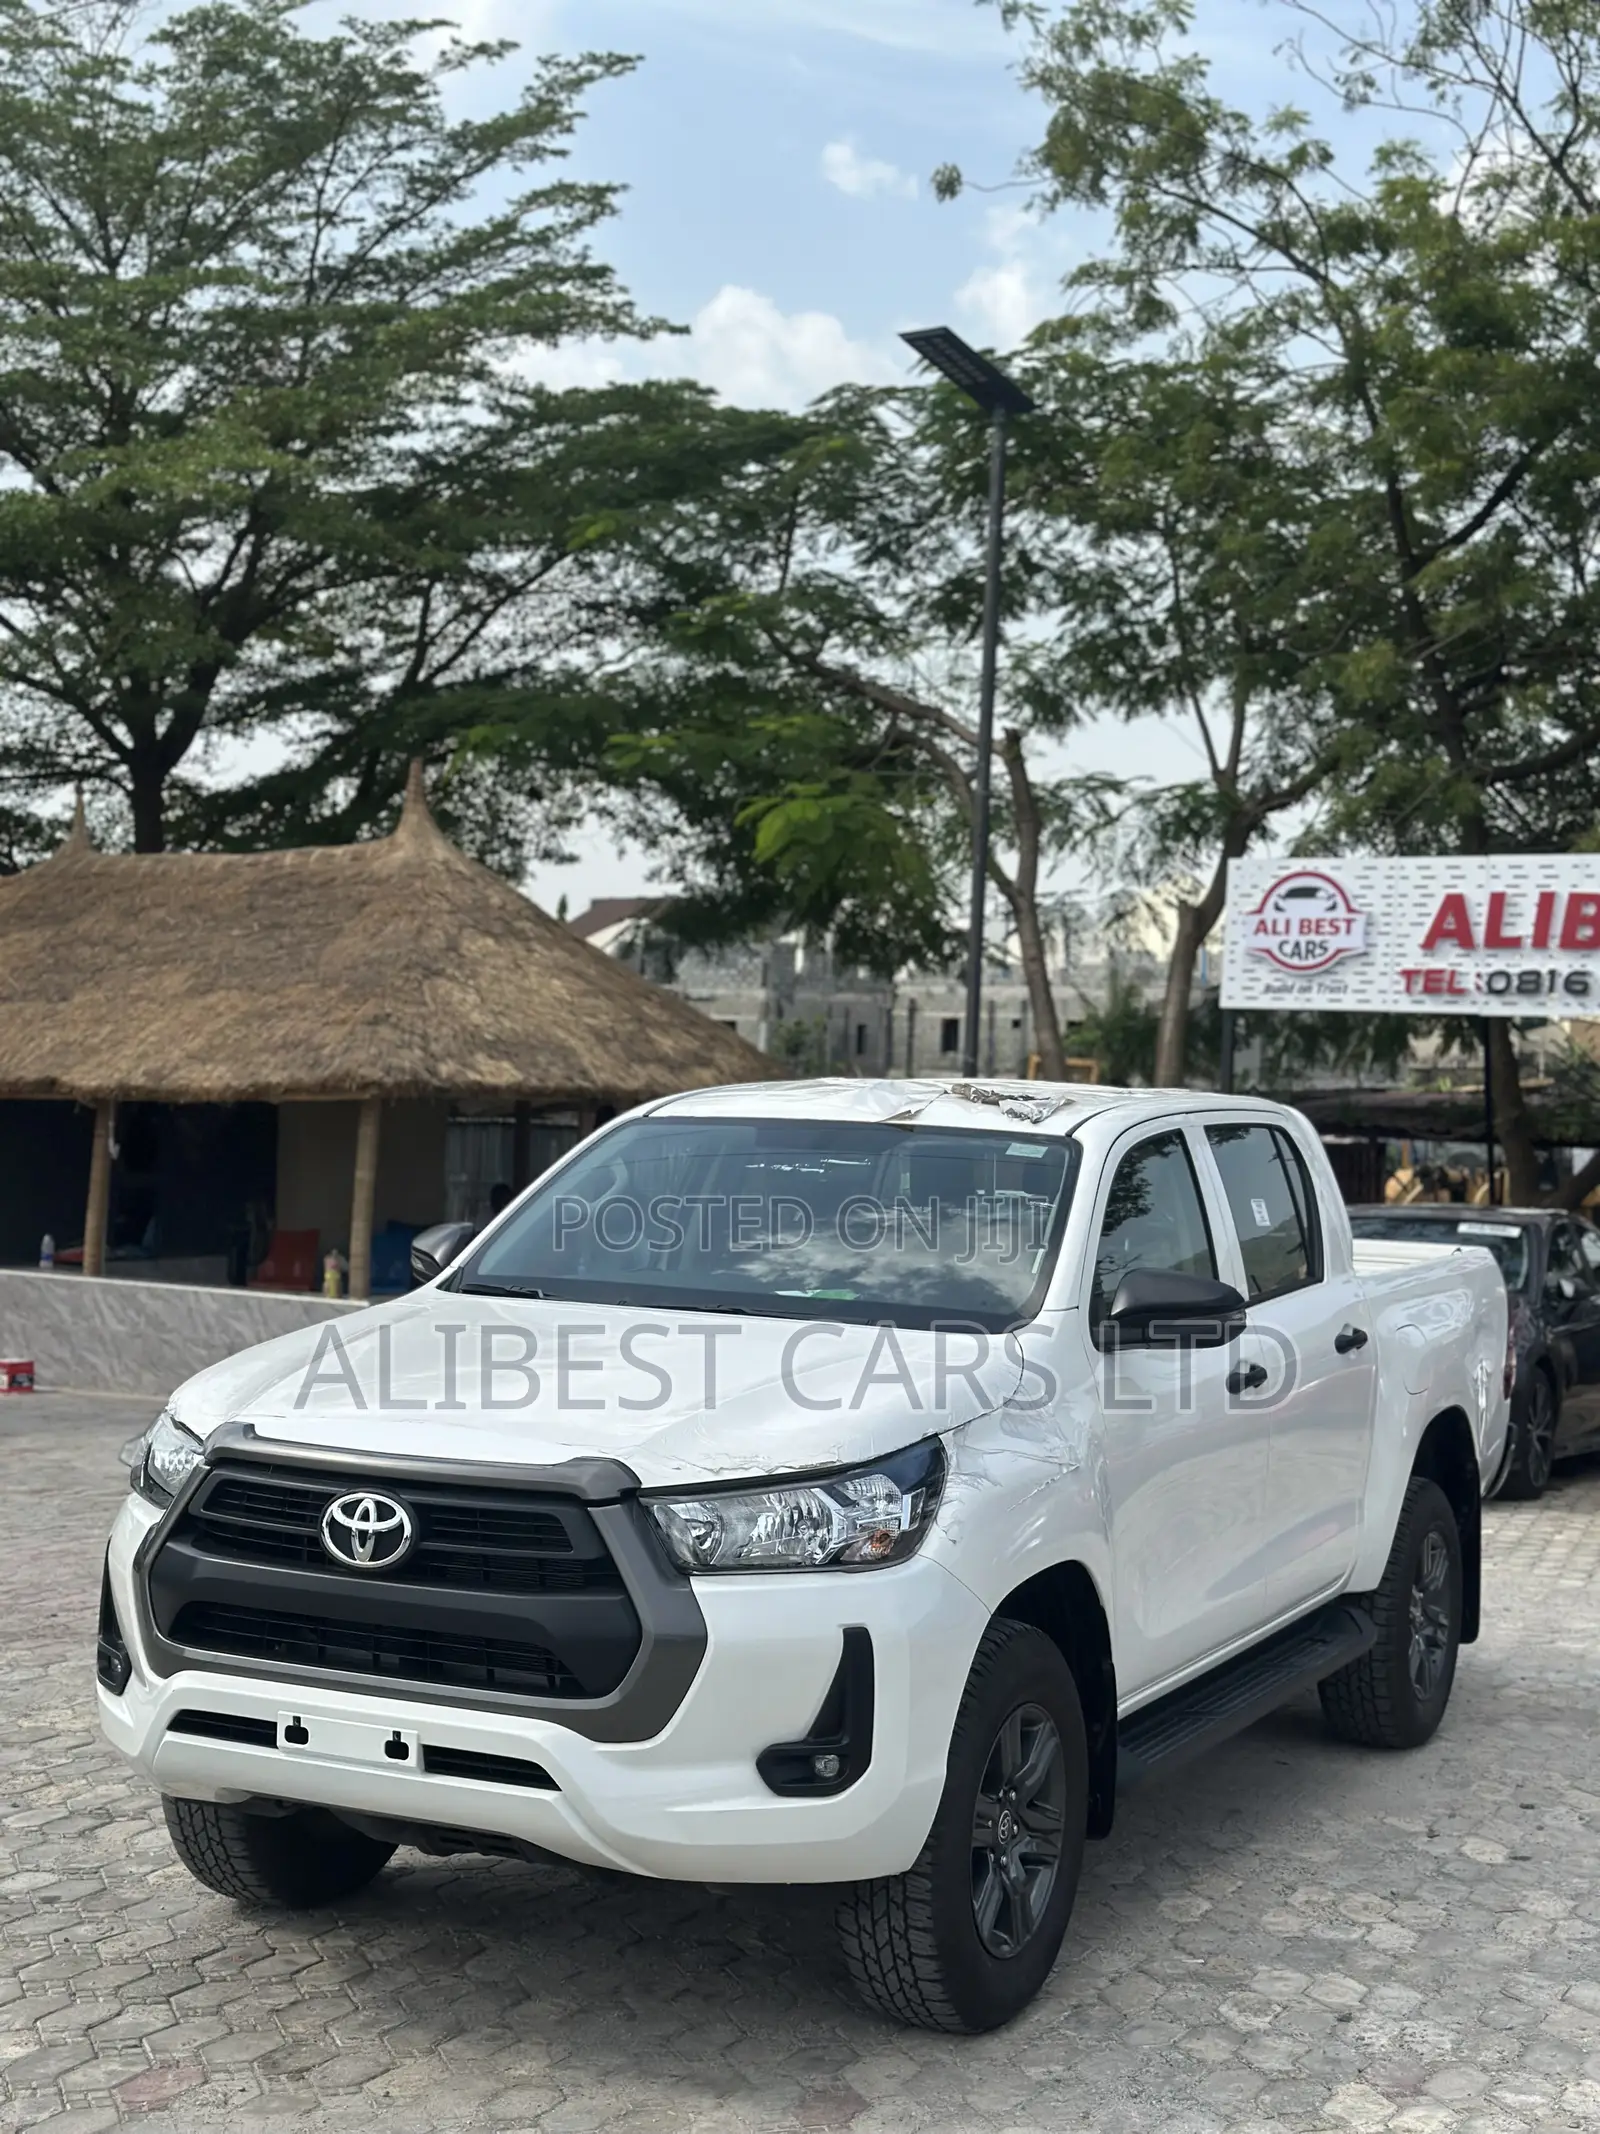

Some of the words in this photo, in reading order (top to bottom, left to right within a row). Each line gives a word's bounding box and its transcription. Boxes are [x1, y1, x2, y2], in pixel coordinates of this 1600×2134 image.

[1253, 918, 1291, 936] ALI
[1298, 918, 1356, 936] BEST
[1278, 940, 1330, 961] CARS
